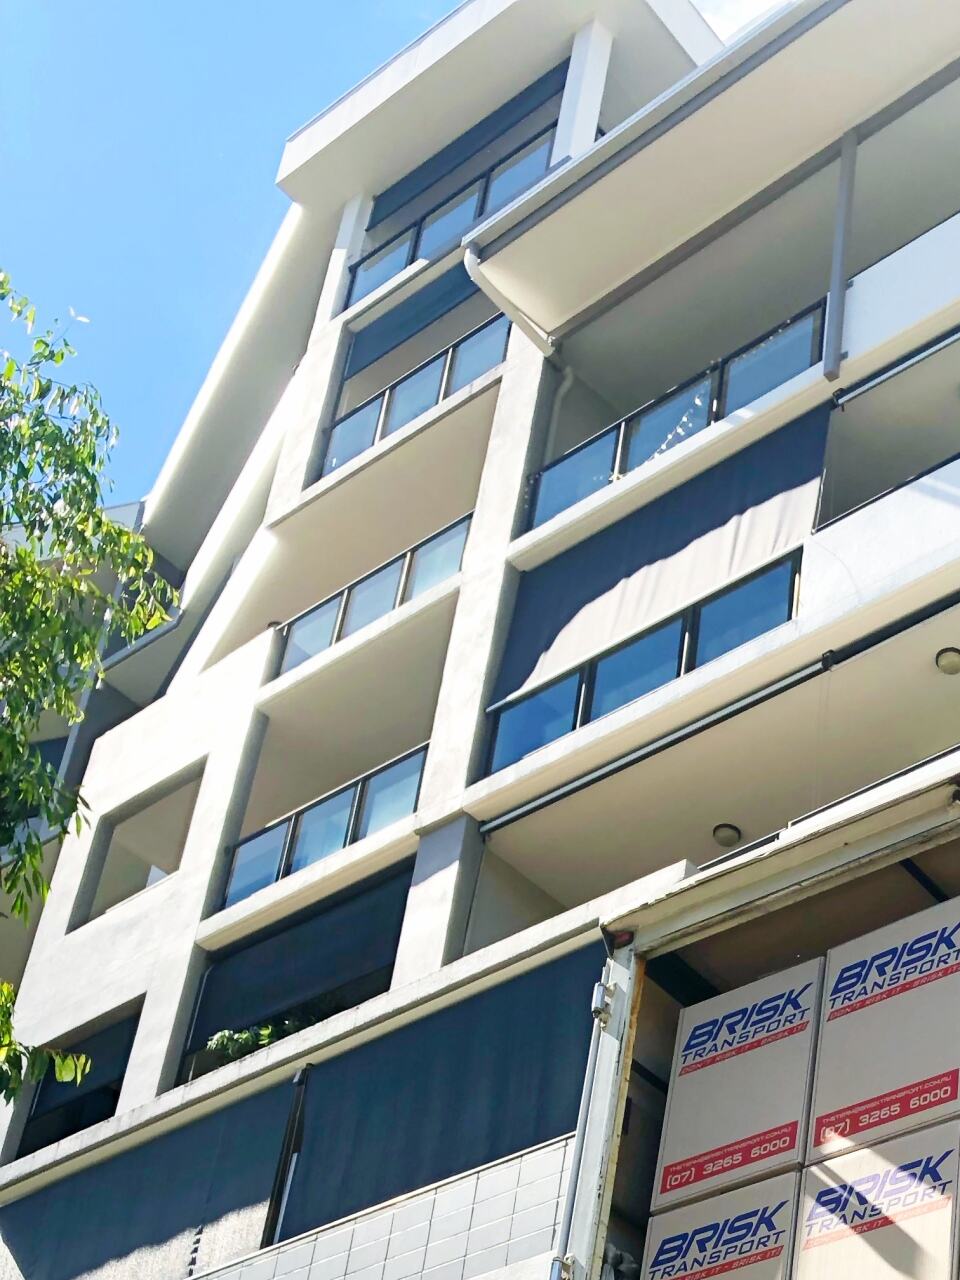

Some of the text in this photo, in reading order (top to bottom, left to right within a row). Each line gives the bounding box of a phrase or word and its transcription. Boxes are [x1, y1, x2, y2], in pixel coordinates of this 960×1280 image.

[681, 1007, 810, 1065] TRANSPORT
[682, 982, 813, 1053] BRISK
[666, 1135, 790, 1189] (07) 3265 6000
[806, 1149, 955, 1223] BRISK
[649, 1199, 789, 1269] BRISK
[805, 1180, 952, 1237] TRANSPORT
